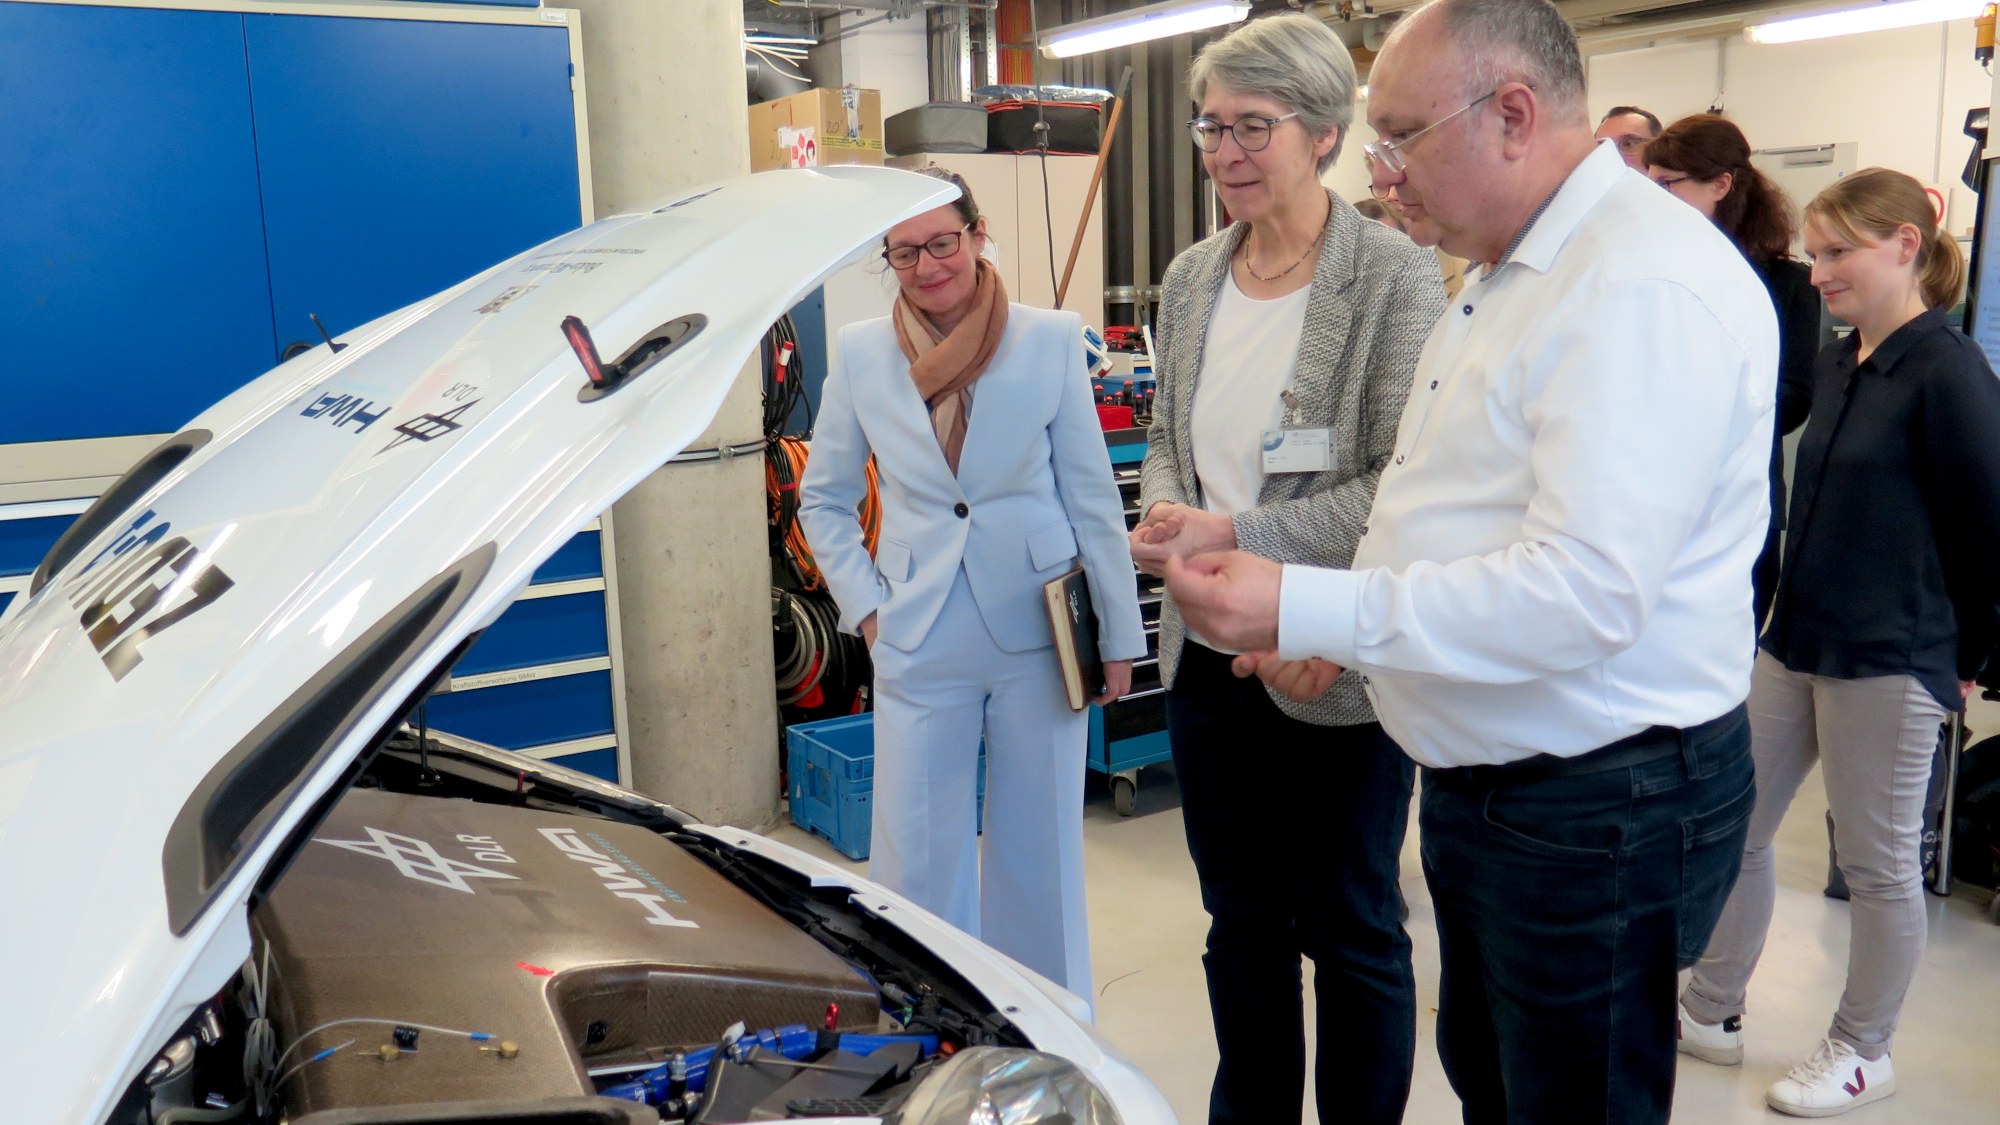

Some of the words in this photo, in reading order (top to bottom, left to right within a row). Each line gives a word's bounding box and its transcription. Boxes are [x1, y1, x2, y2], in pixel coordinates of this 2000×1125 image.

[442, 382, 478, 402] DLR
[453, 675, 517, 689] Kraftstoffversorgung
[519, 672, 536, 680] BMW
[456, 834, 518, 864] DLR
